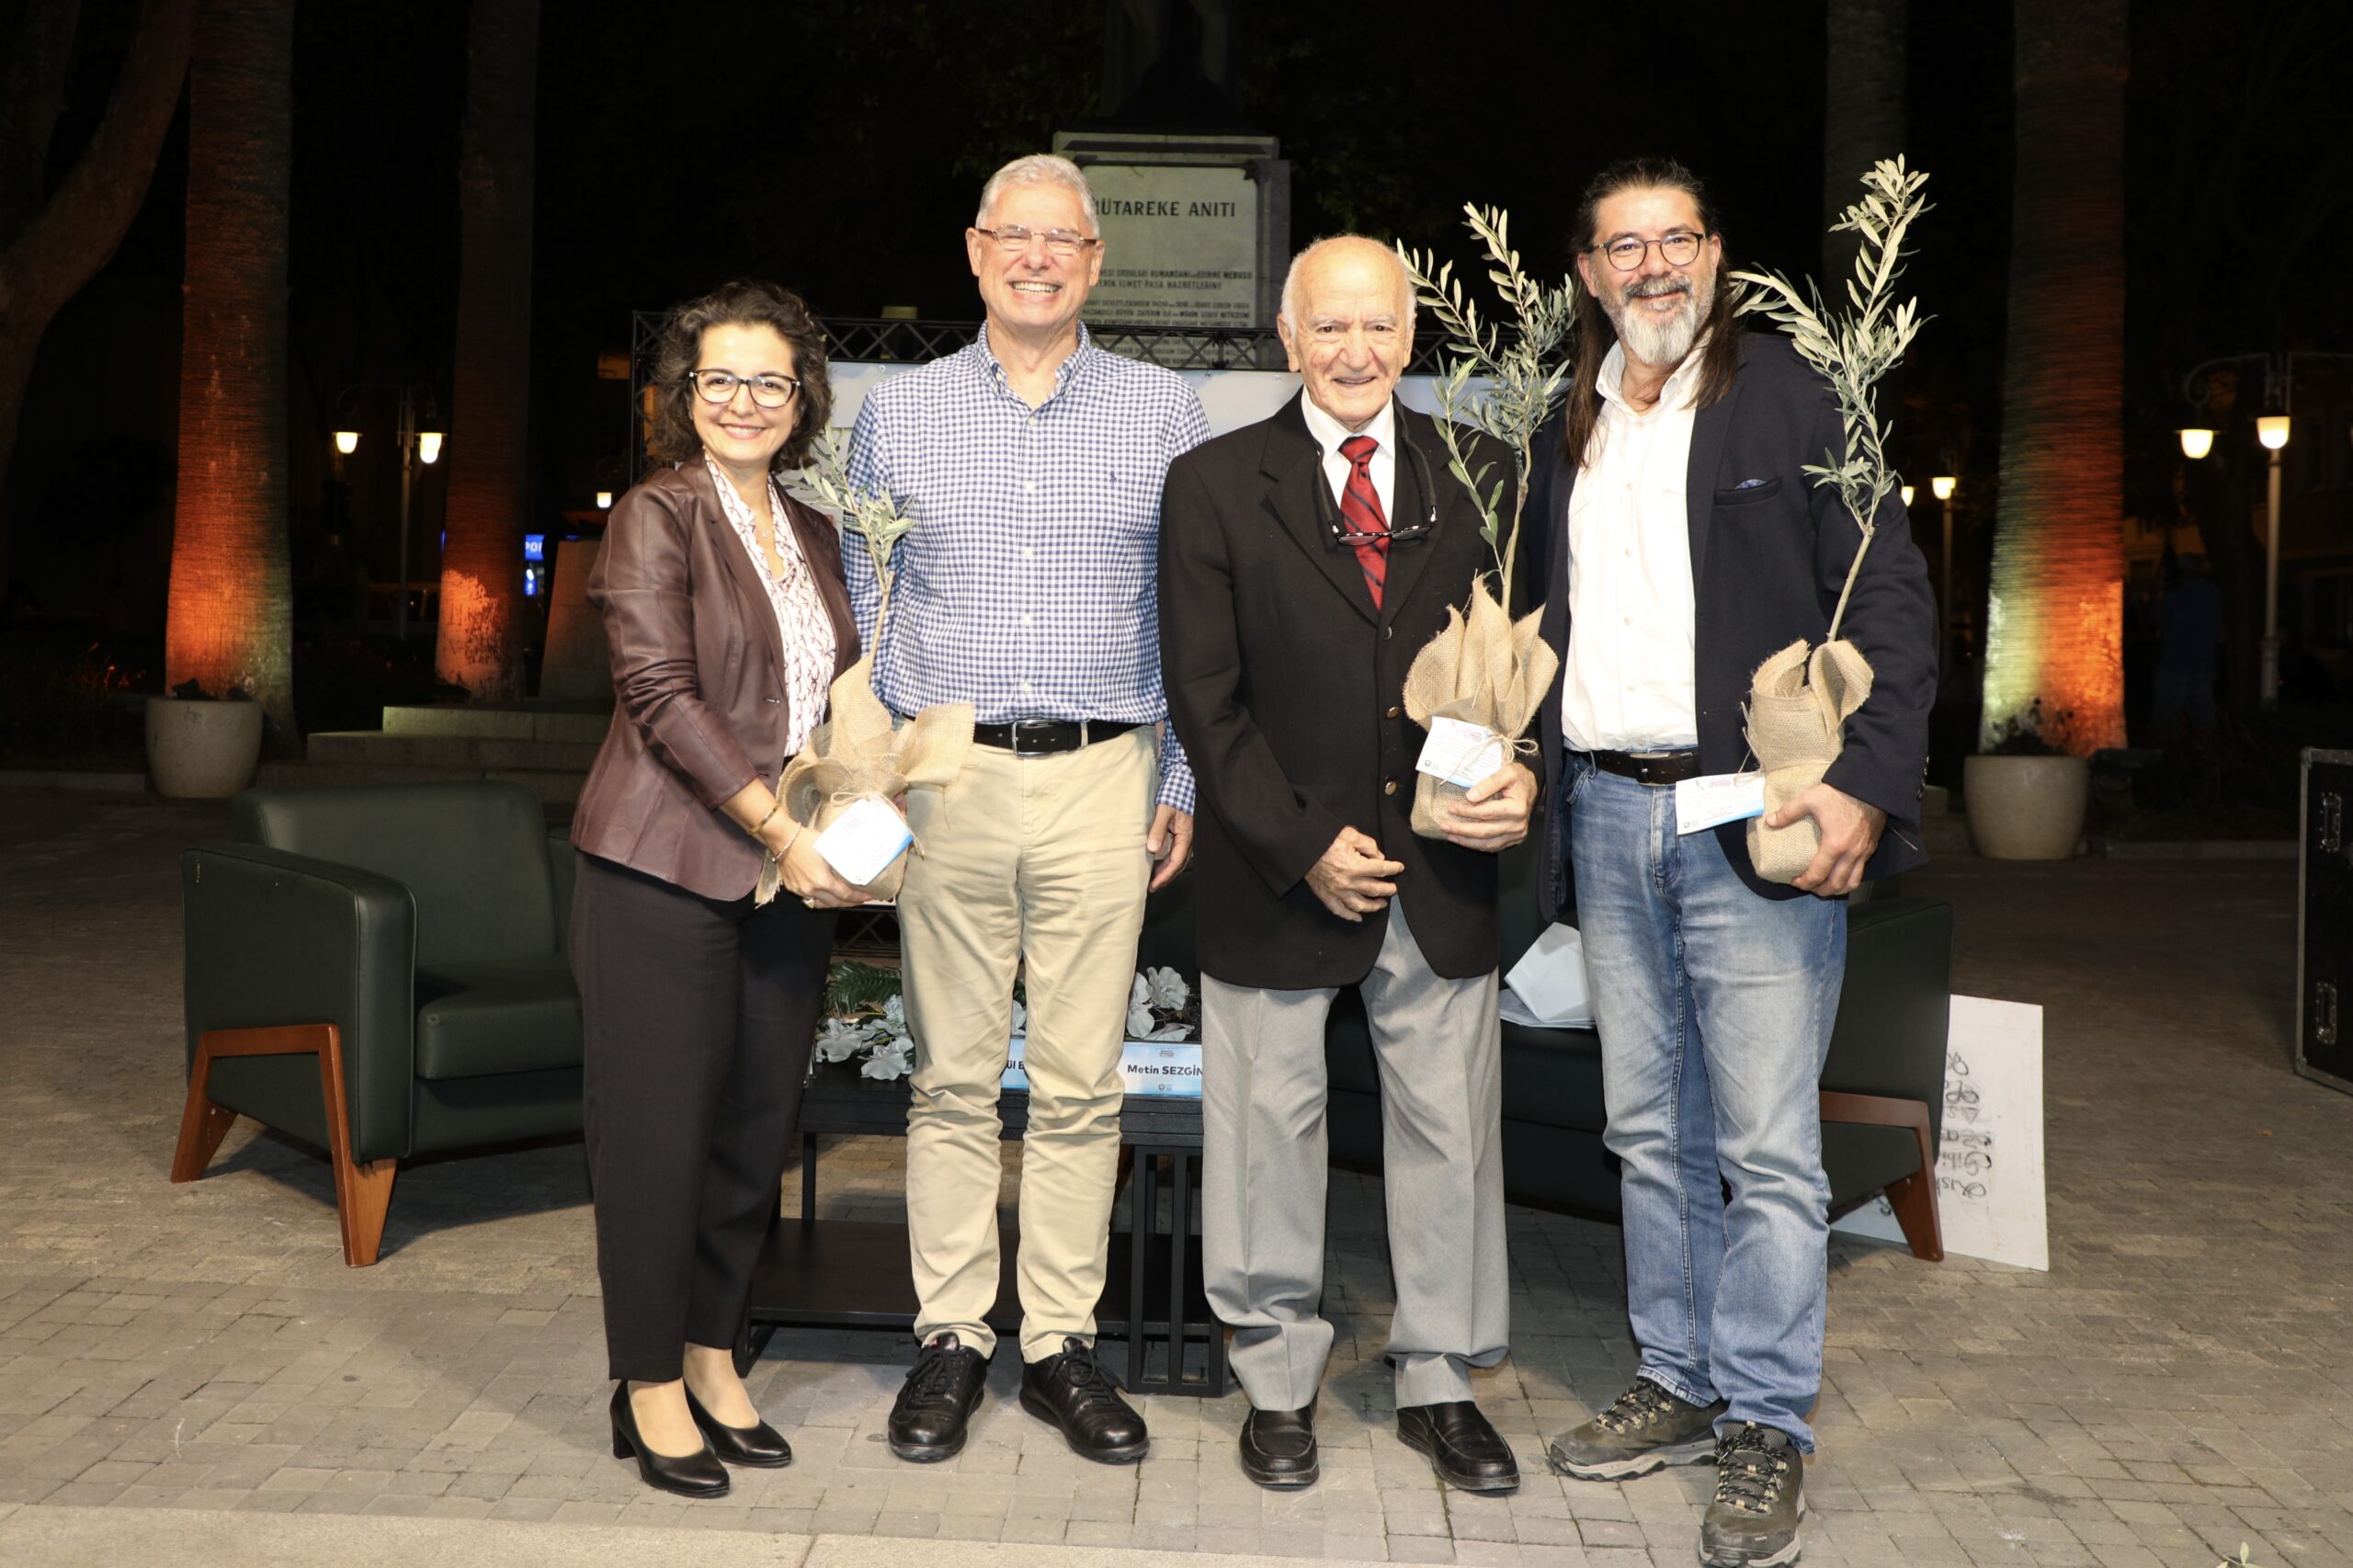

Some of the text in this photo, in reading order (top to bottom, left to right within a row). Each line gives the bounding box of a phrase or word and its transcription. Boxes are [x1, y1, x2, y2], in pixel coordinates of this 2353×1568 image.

[1188, 201, 1235, 217] ANITI
[1127, 1064, 1203, 1076] Metin SEZGİN
